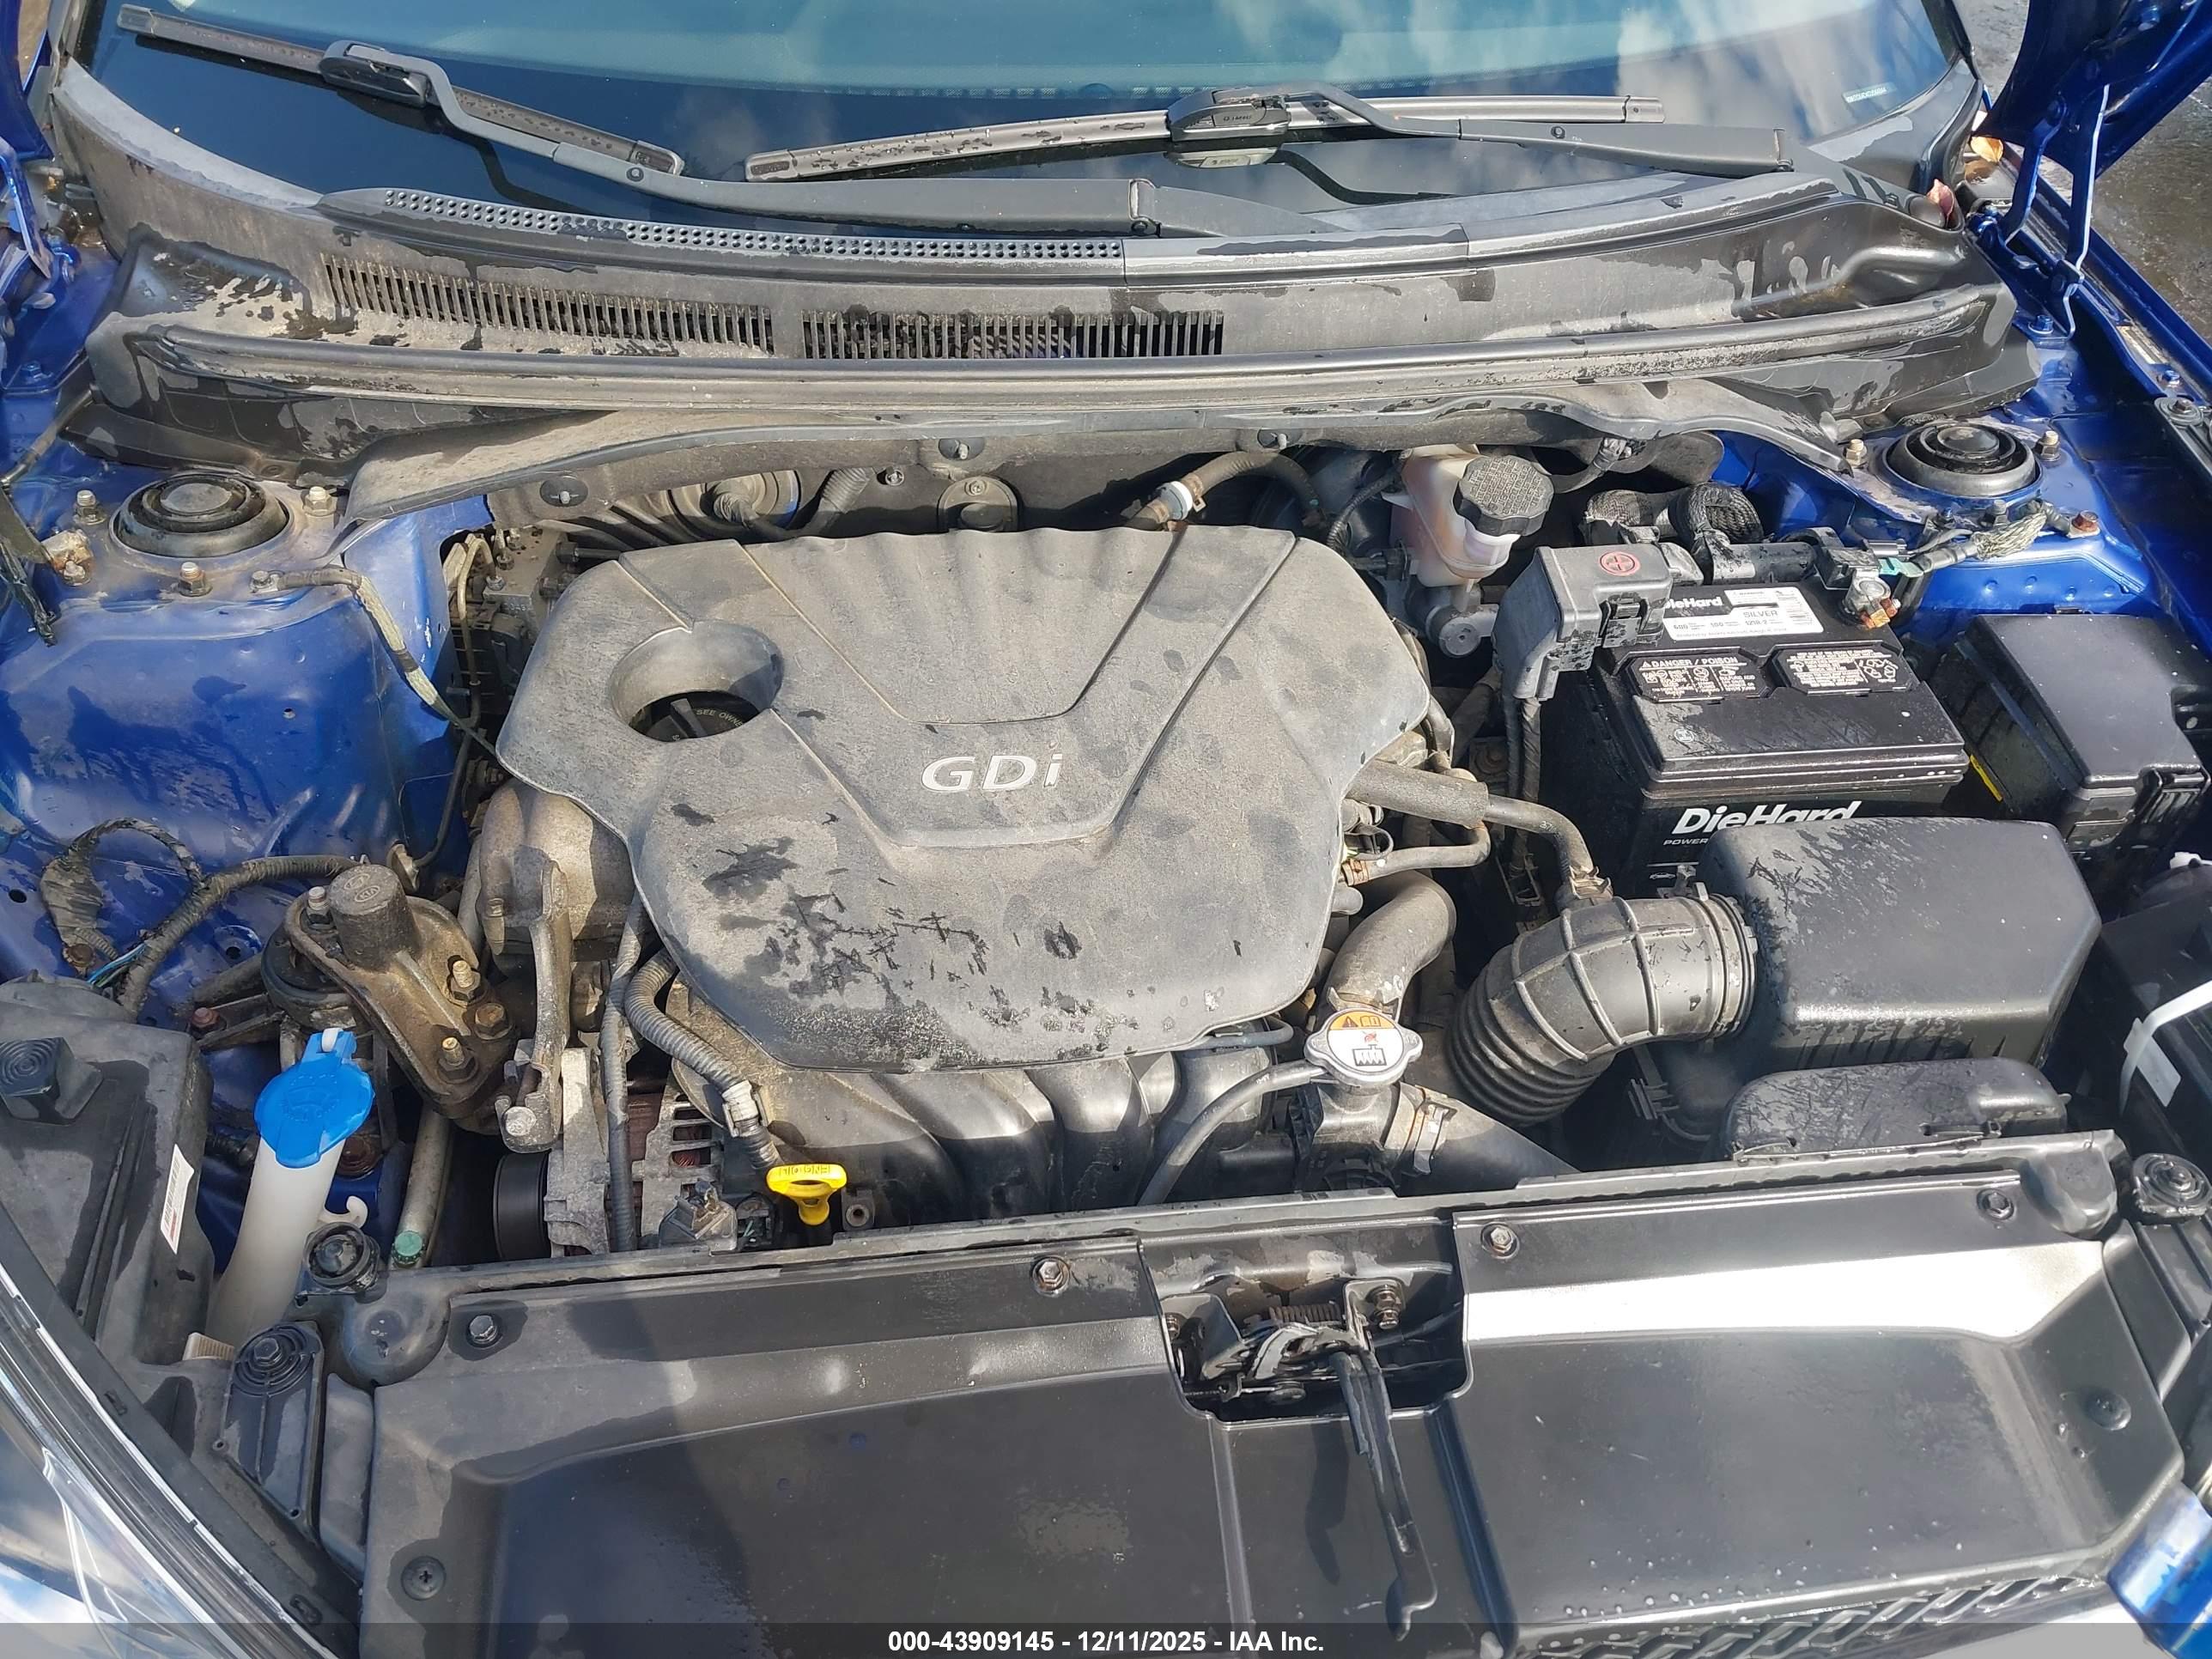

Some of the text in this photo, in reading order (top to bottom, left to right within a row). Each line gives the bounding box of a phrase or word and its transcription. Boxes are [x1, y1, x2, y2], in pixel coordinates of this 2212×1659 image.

[1651, 659, 1692, 668] DANGER
[1702, 657, 1739, 665] POISON
[921, 753, 1063, 793] GDi
[1672, 800, 1862, 834] DieHard
[778, 1164, 830, 1176] ENG OIL
